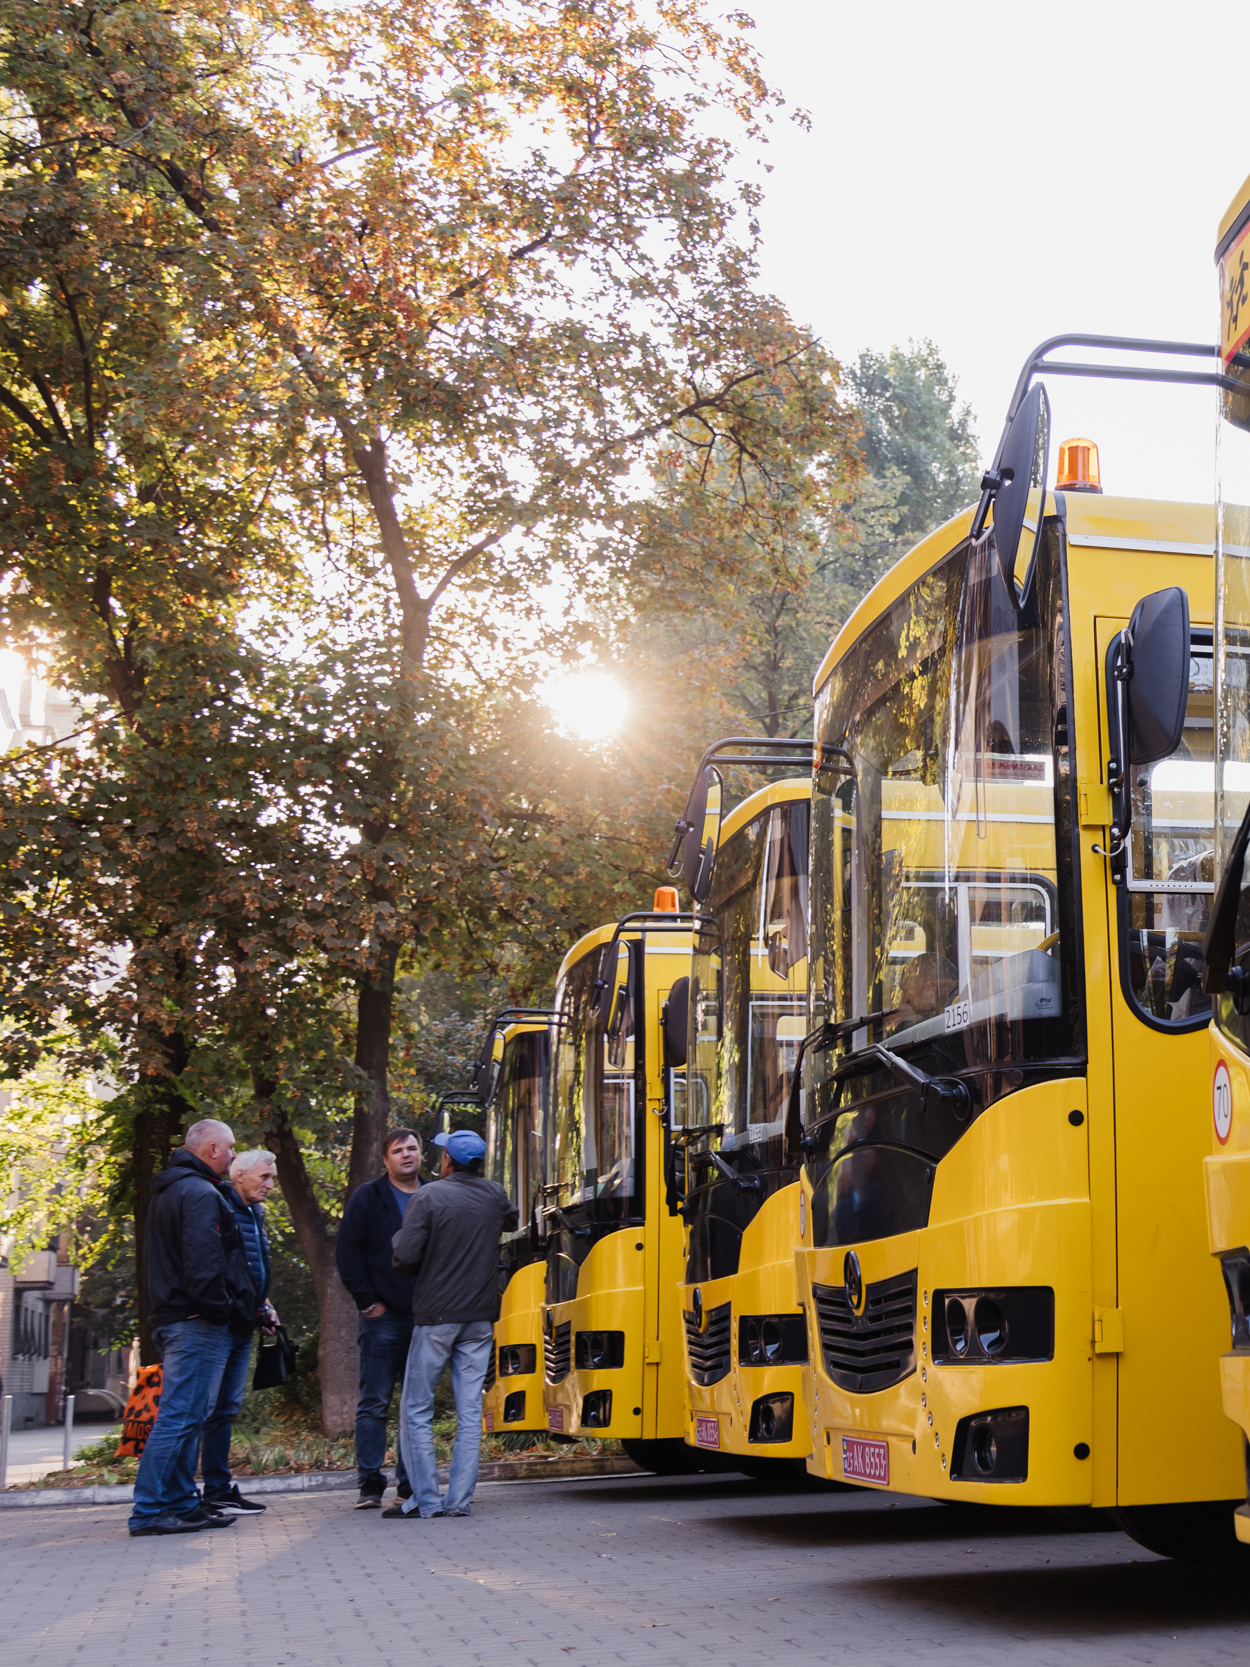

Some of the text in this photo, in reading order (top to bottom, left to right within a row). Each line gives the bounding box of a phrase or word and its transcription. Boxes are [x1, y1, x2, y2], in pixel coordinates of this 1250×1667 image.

[946, 1003, 969, 1029] 2156
[1216, 1083, 1229, 1120] 70
[854, 1444, 864, 1474] AK
